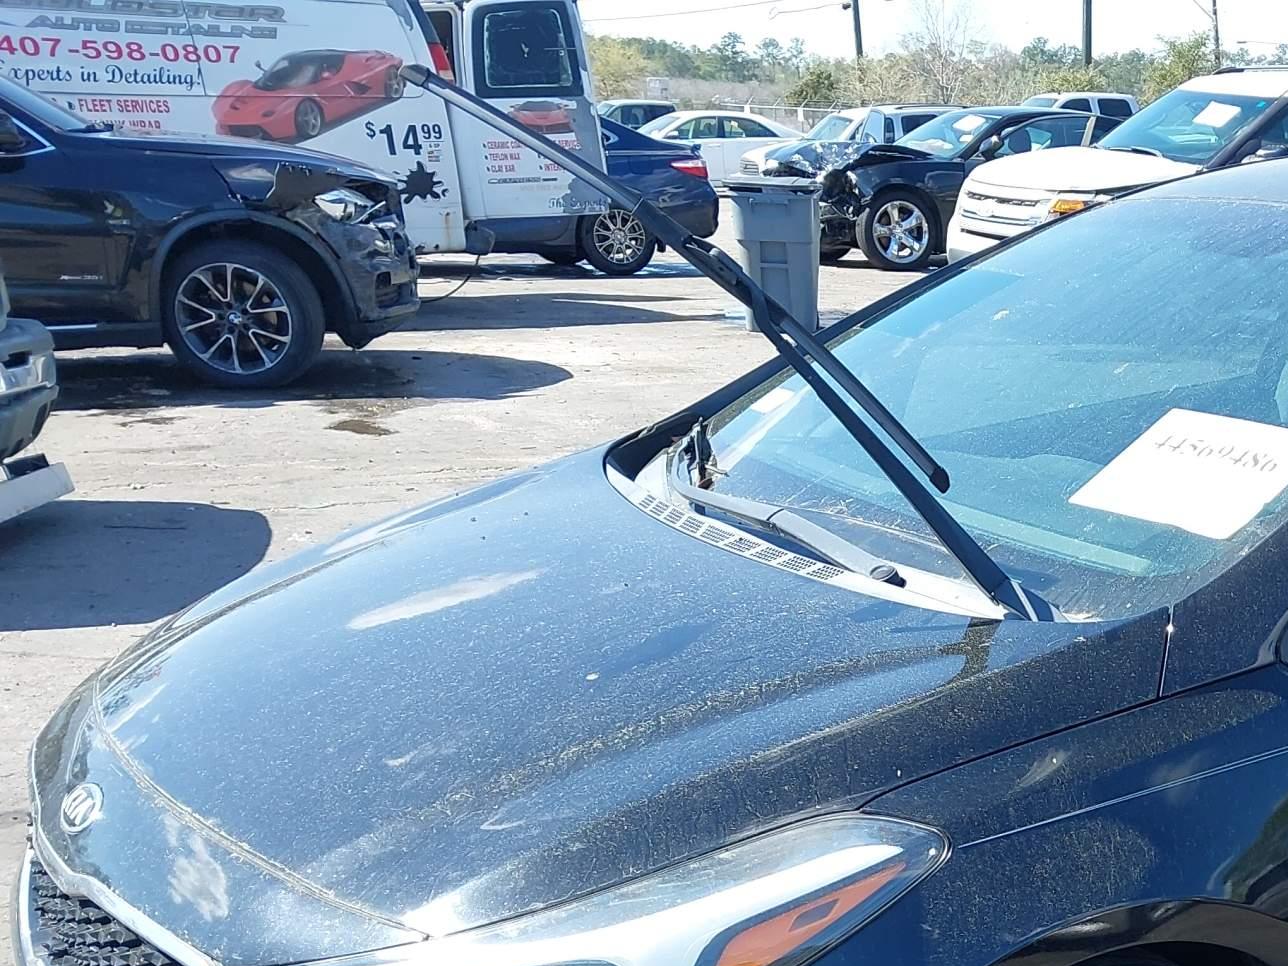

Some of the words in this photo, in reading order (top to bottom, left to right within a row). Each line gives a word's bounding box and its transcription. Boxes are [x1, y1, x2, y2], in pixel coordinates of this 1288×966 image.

[0, 35, 240, 63] 407-598-0807
[80, 66, 99, 82] in
[105, 65, 201, 91] Detailing!
[78, 98, 113, 112] FLEET
[117, 99, 170, 113] SERVICES
